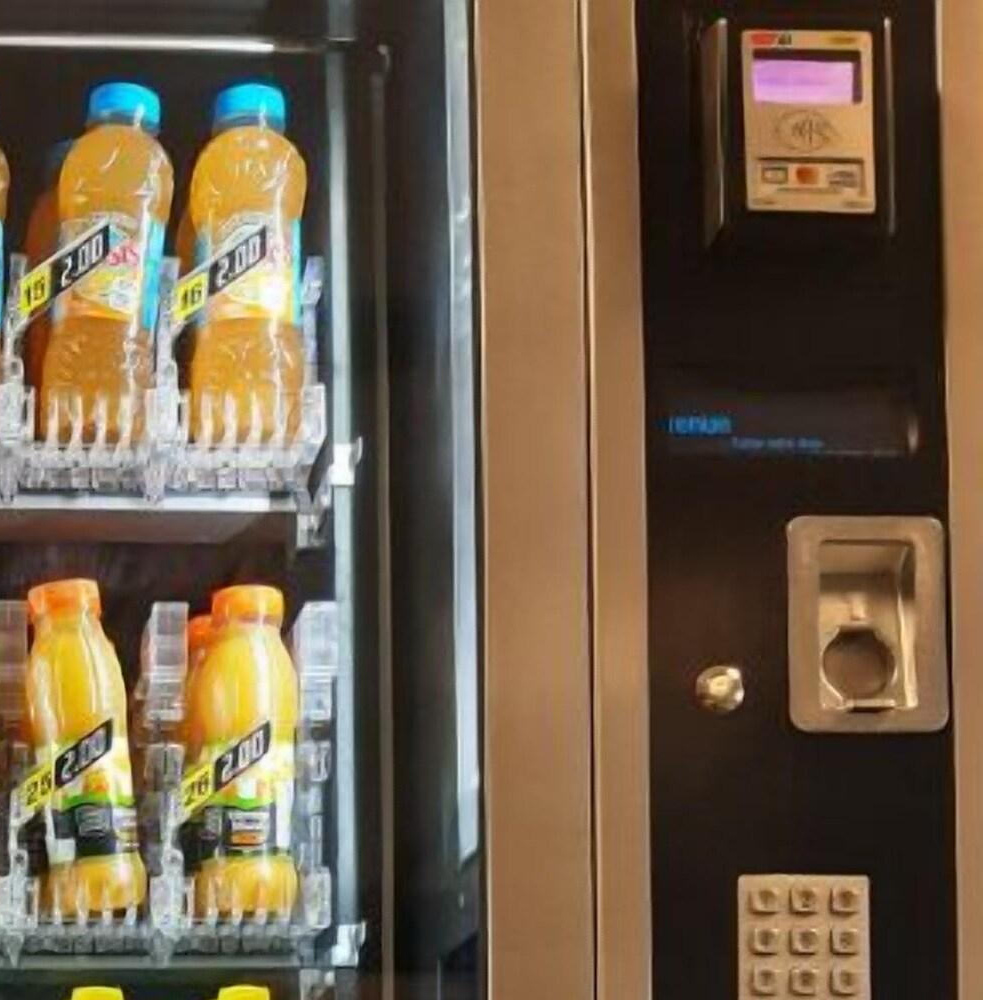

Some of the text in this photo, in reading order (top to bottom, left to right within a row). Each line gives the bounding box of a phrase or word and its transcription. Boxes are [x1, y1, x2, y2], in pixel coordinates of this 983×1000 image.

[61, 233, 104, 288] 2.00
[218, 234, 260, 287] 2.00
[221, 729, 265, 781] 2.00
